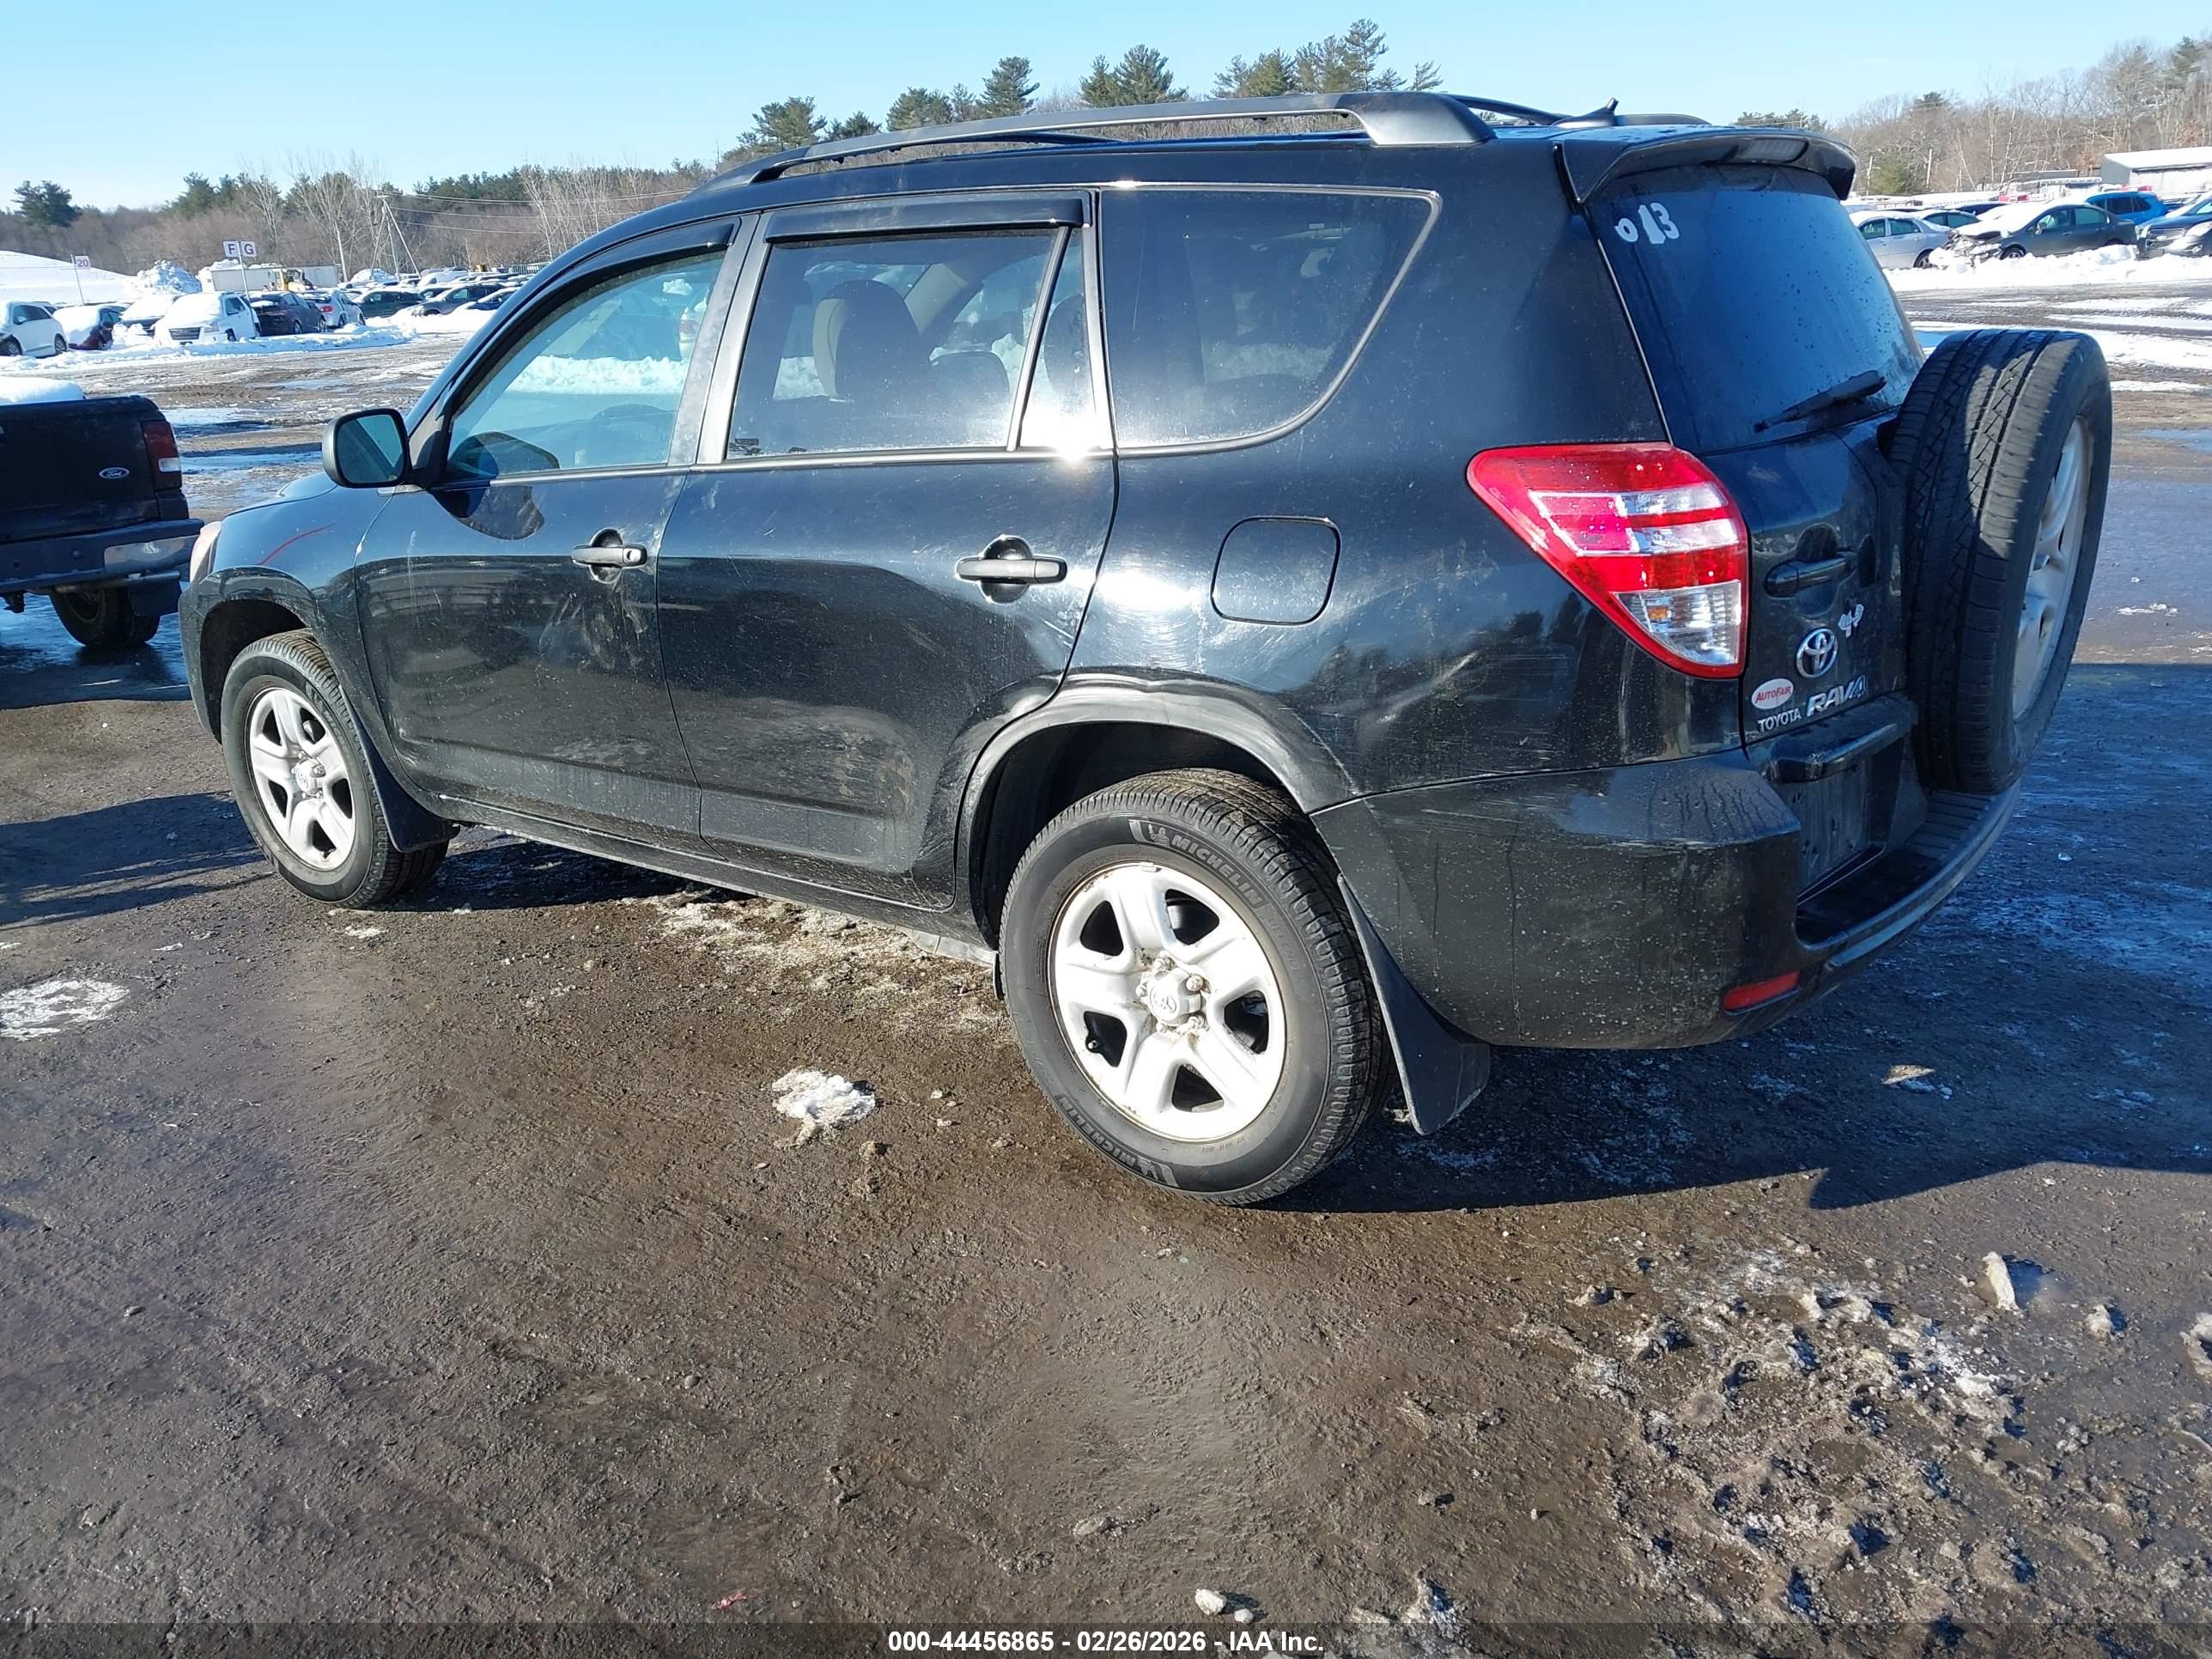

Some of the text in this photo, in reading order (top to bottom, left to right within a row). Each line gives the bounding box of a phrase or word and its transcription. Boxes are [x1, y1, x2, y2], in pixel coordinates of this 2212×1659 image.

[76, 259, 88, 268] 20
[228, 244, 235, 254] F
[244, 244, 254, 255] G
[1759, 674, 1866, 732] TOYOTA RAV4
[1170, 834, 1263, 906] MICHELIN
[1059, 1096, 1136, 1166] MICHELIN
